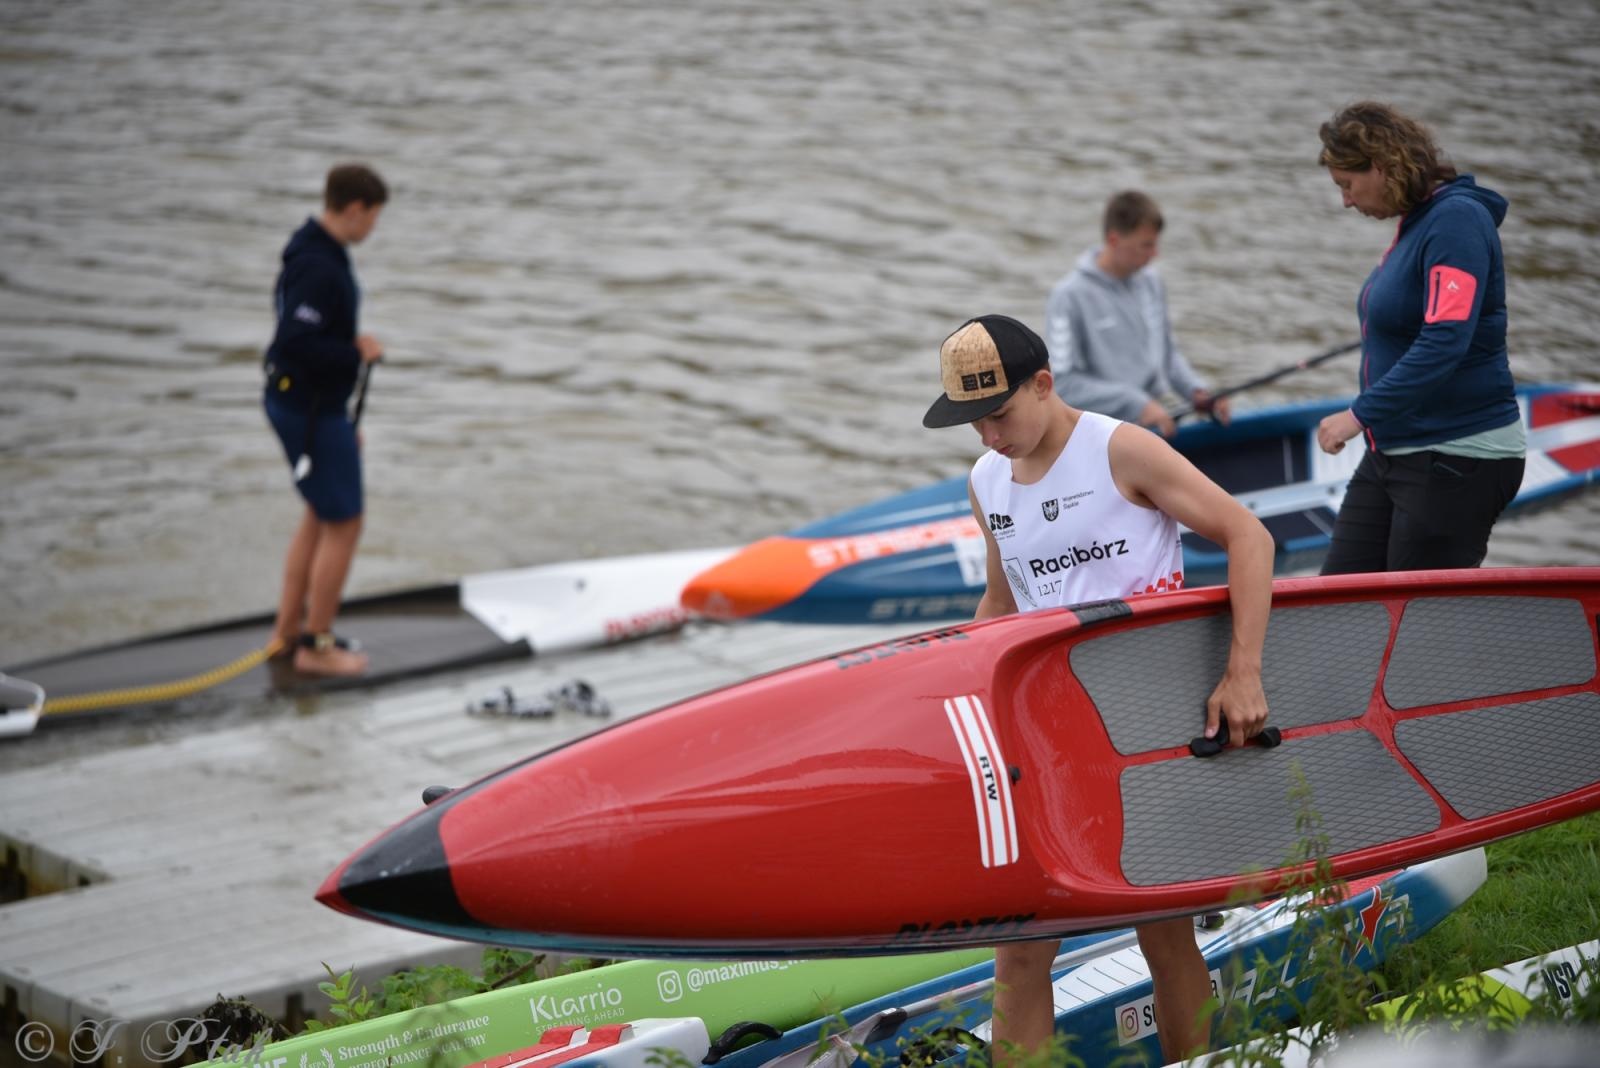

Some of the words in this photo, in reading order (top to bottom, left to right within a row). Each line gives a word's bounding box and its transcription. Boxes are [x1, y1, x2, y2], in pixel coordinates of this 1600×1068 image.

[1029, 538, 1129, 578] Racibórz
[1037, 579, 1063, 598] 1217
[979, 755, 998, 800] RTW
[686, 959, 809, 992] @maximus_
[529, 982, 623, 1025] Klarrio
[594, 1007, 626, 1024] AHEAD
[339, 1033, 400, 1061] Strength
[416, 1014, 490, 1041] Endurance
